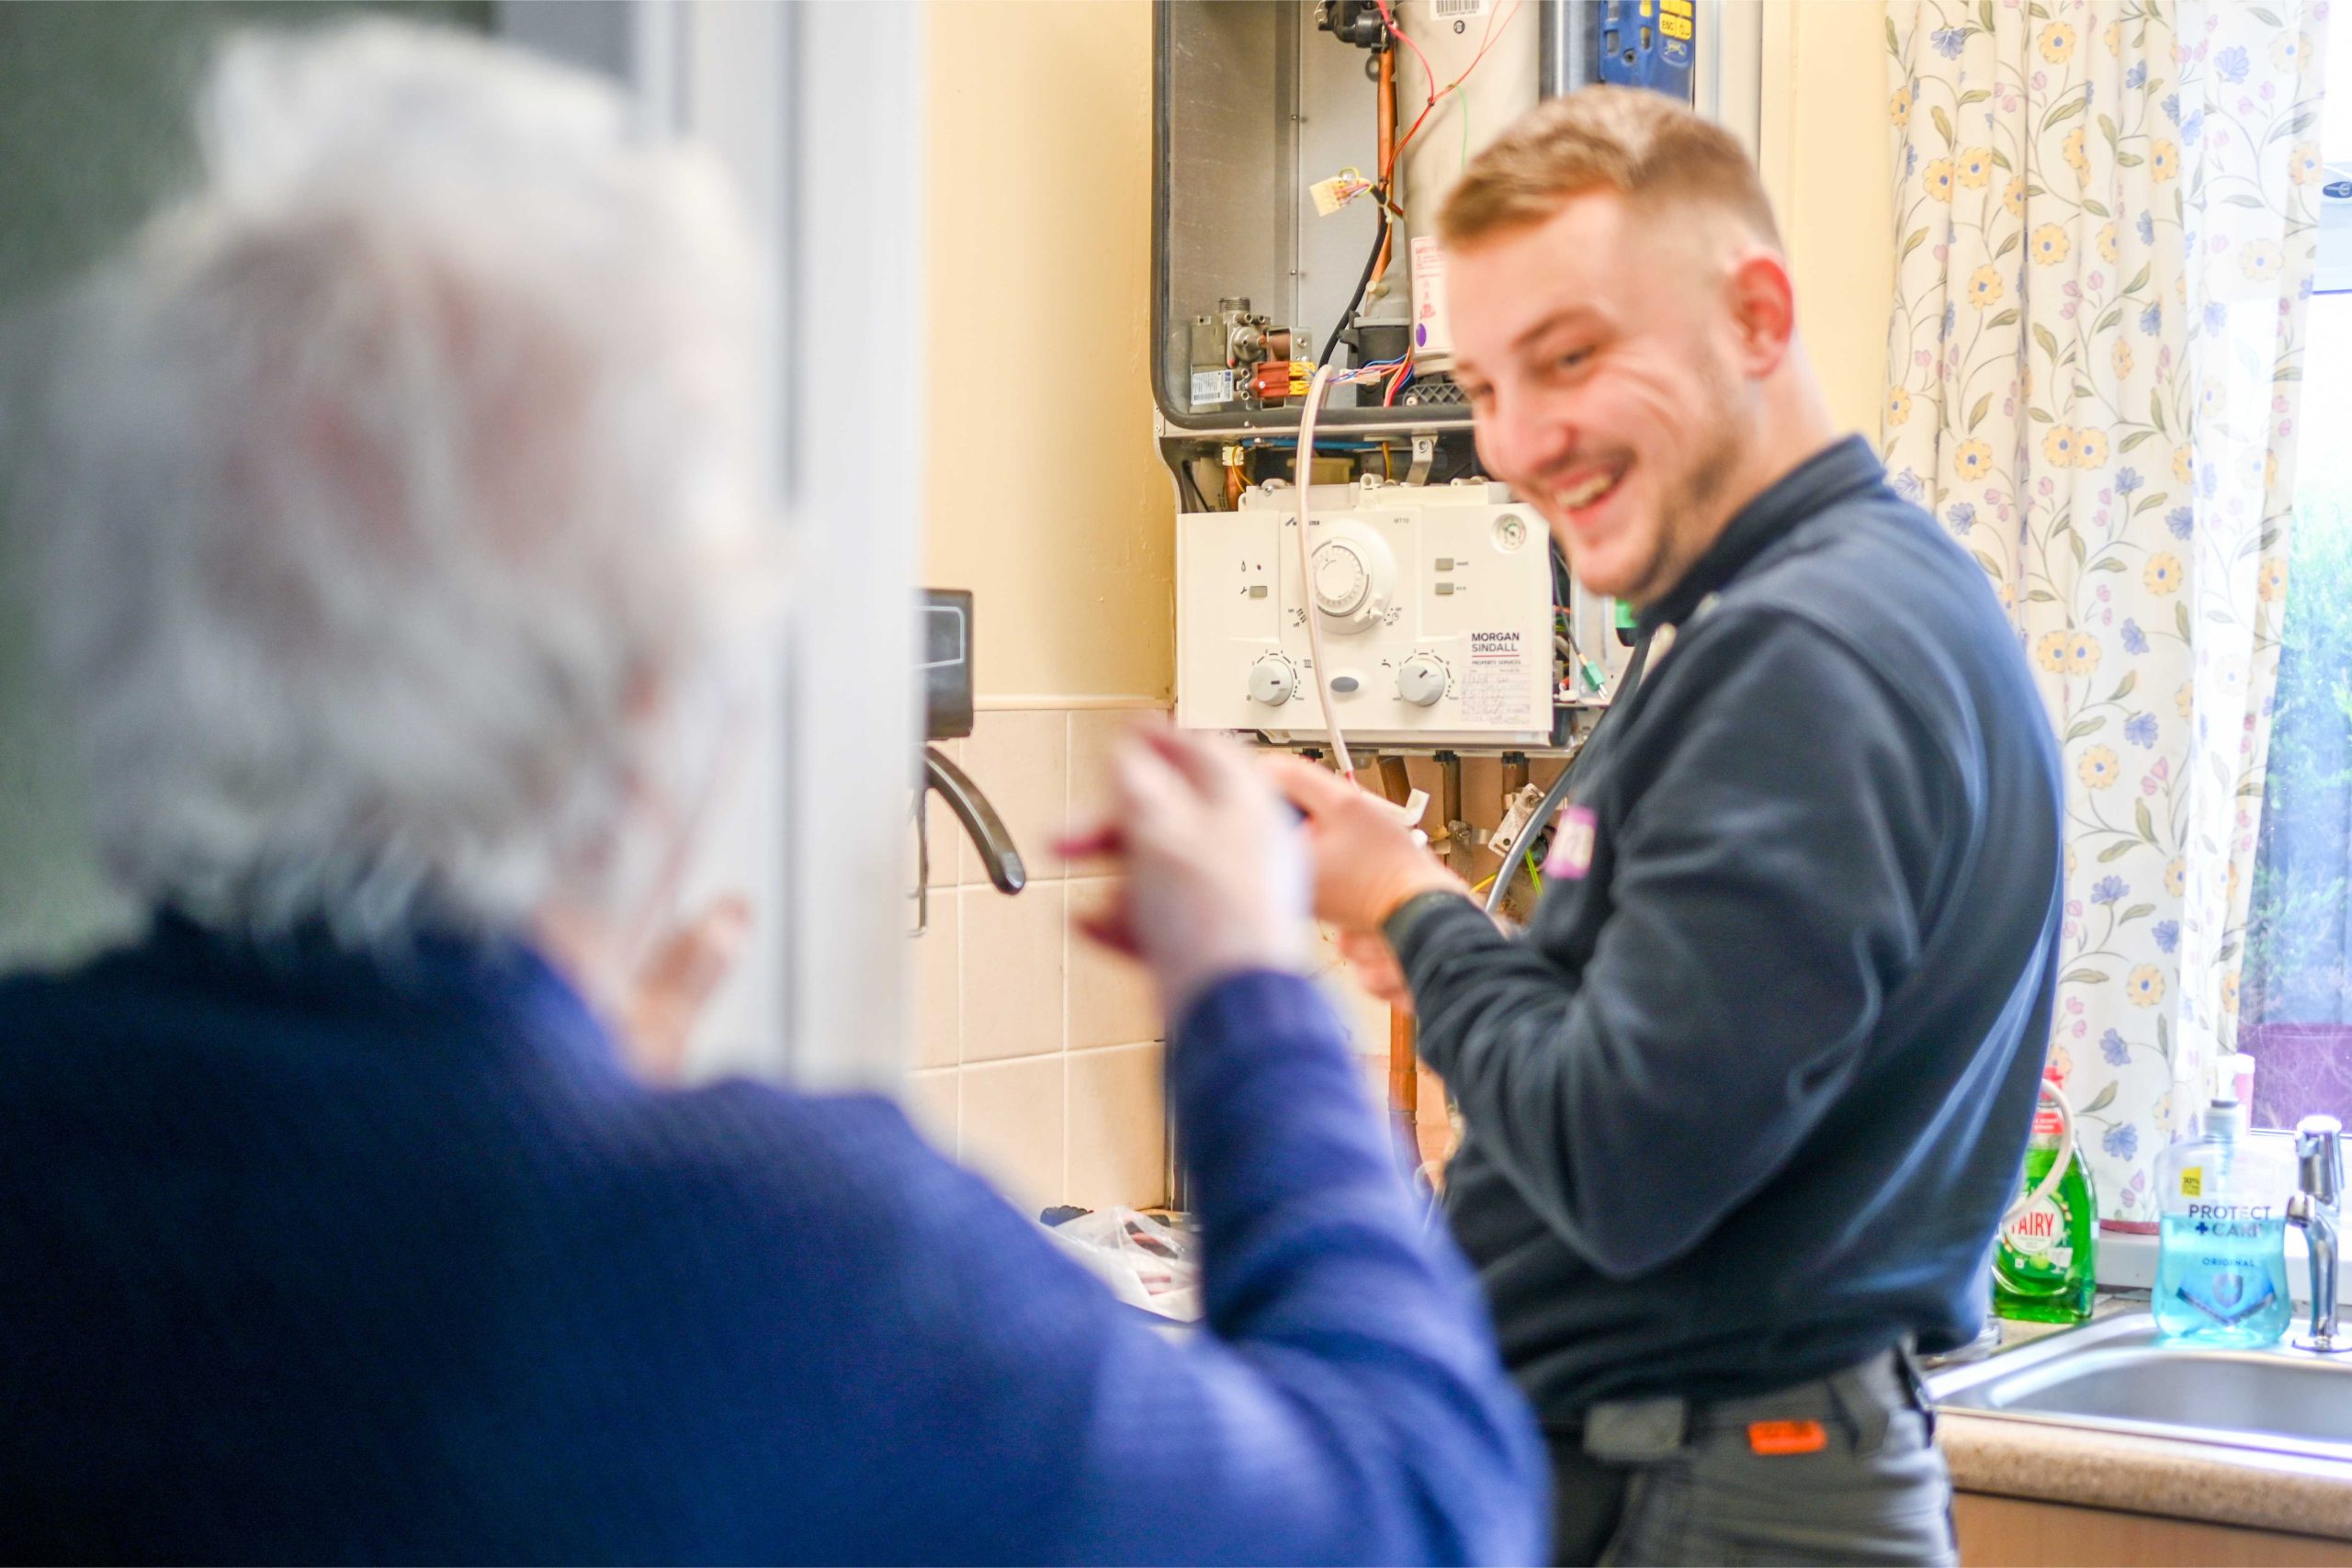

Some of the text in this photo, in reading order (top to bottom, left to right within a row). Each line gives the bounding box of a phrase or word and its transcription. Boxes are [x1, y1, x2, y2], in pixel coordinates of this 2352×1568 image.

[1471, 632, 1520, 642] MORGAN
[1471, 643, 1518, 652] SINDALL
[2188, 1203, 2271, 1220] PROTECT
[2201, 1258, 2255, 1267] ORIGINAL
